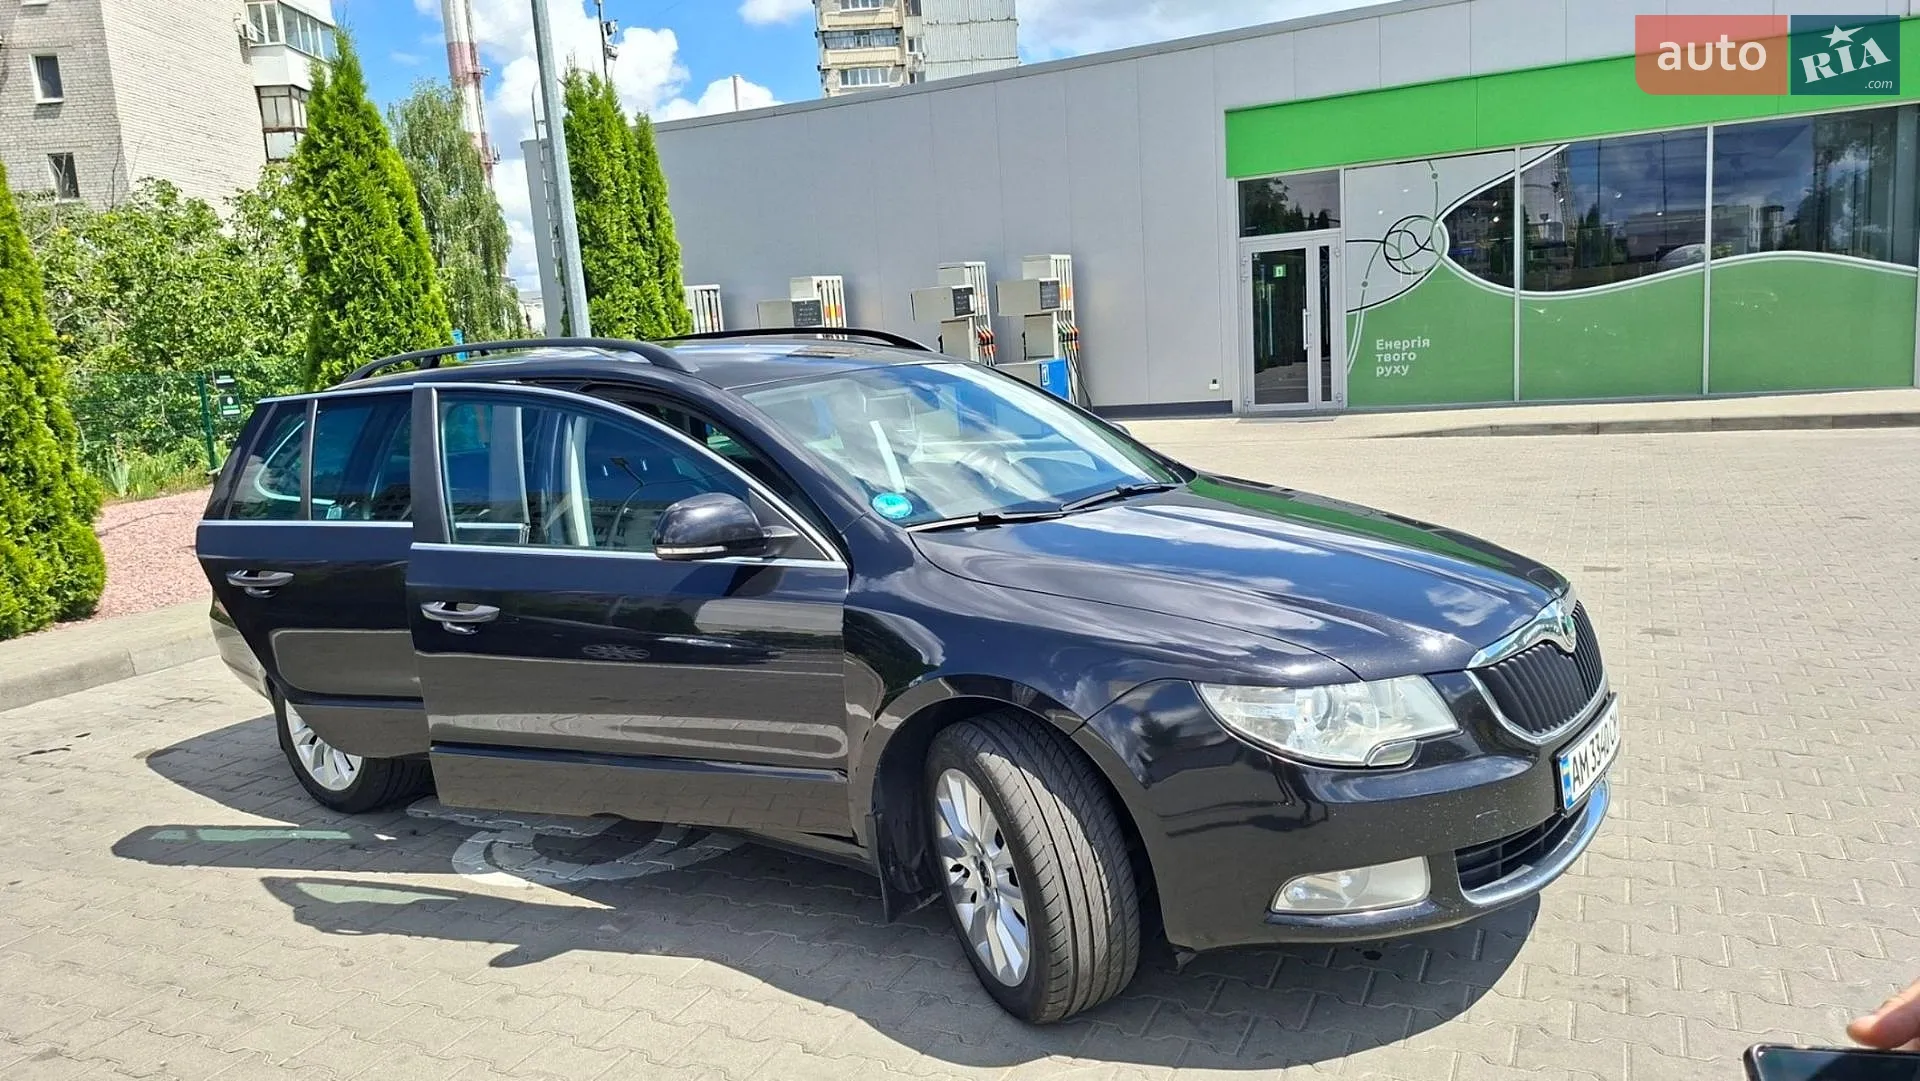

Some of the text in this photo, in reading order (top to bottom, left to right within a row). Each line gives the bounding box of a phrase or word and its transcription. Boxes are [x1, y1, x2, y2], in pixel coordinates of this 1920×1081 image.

[1376, 336, 1430, 350] Енергія
[1375, 352, 1416, 362] твого
[1376, 365, 1409, 377] руху
[1573, 746, 1590, 793] AM
[1590, 723, 1610, 772] 3340
